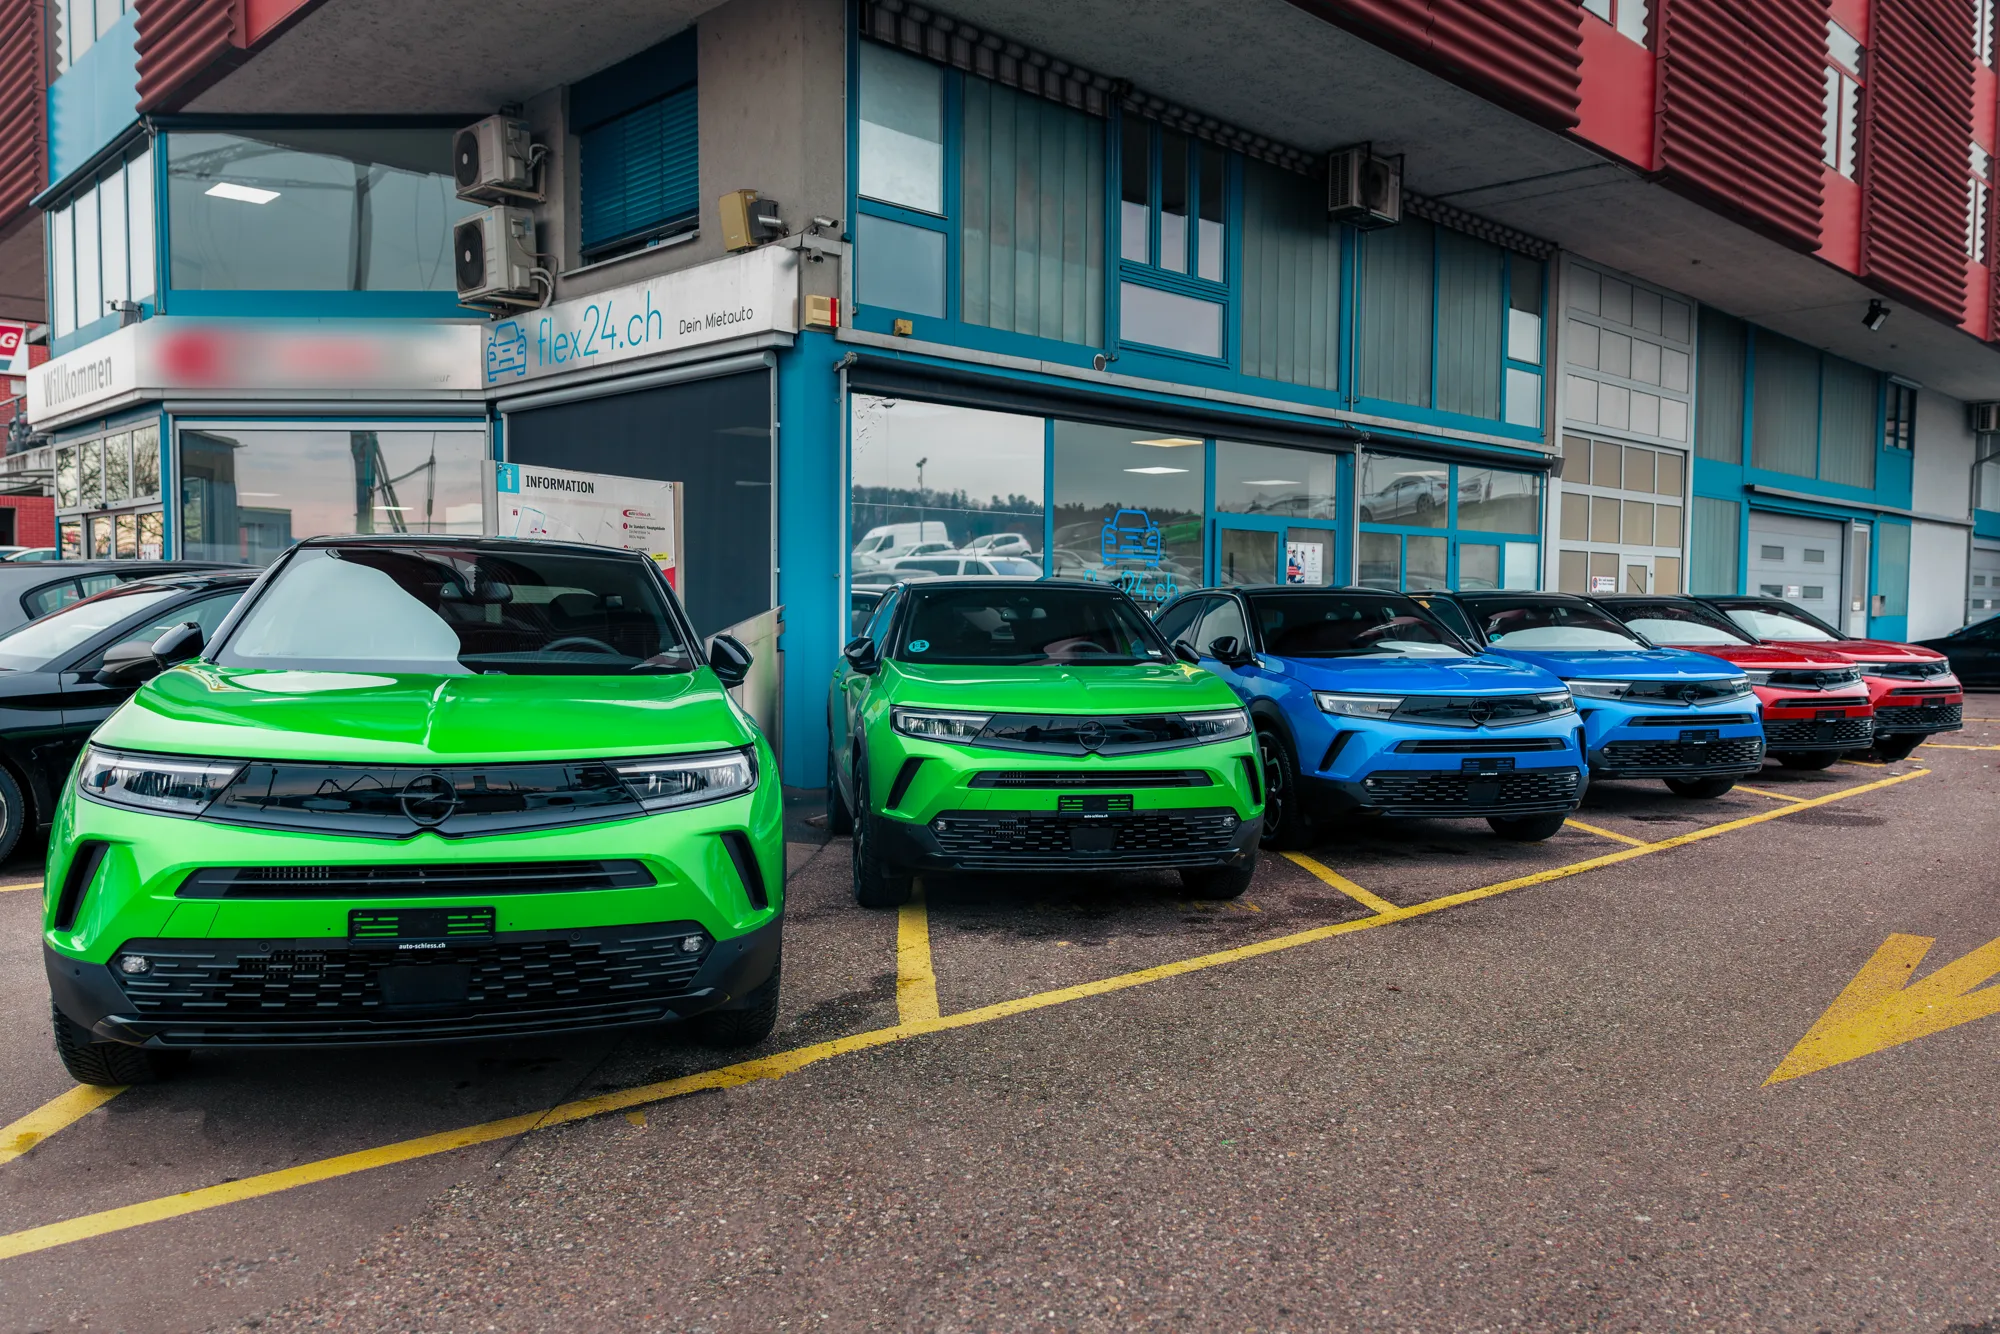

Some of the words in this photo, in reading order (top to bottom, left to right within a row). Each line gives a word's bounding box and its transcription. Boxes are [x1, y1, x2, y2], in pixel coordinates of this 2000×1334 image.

[537, 290, 662, 367] flex24.ch
[679, 317, 702, 335] Dein
[705, 306, 754, 329] Mietauto
[0, 331, 19, 348] G
[43, 356, 112, 408] Willkommen
[525, 475, 595, 494] INFORMATION
[1083, 569, 1179, 602] 24.ch
[398, 942, 446, 950] auto-schiess.ch
